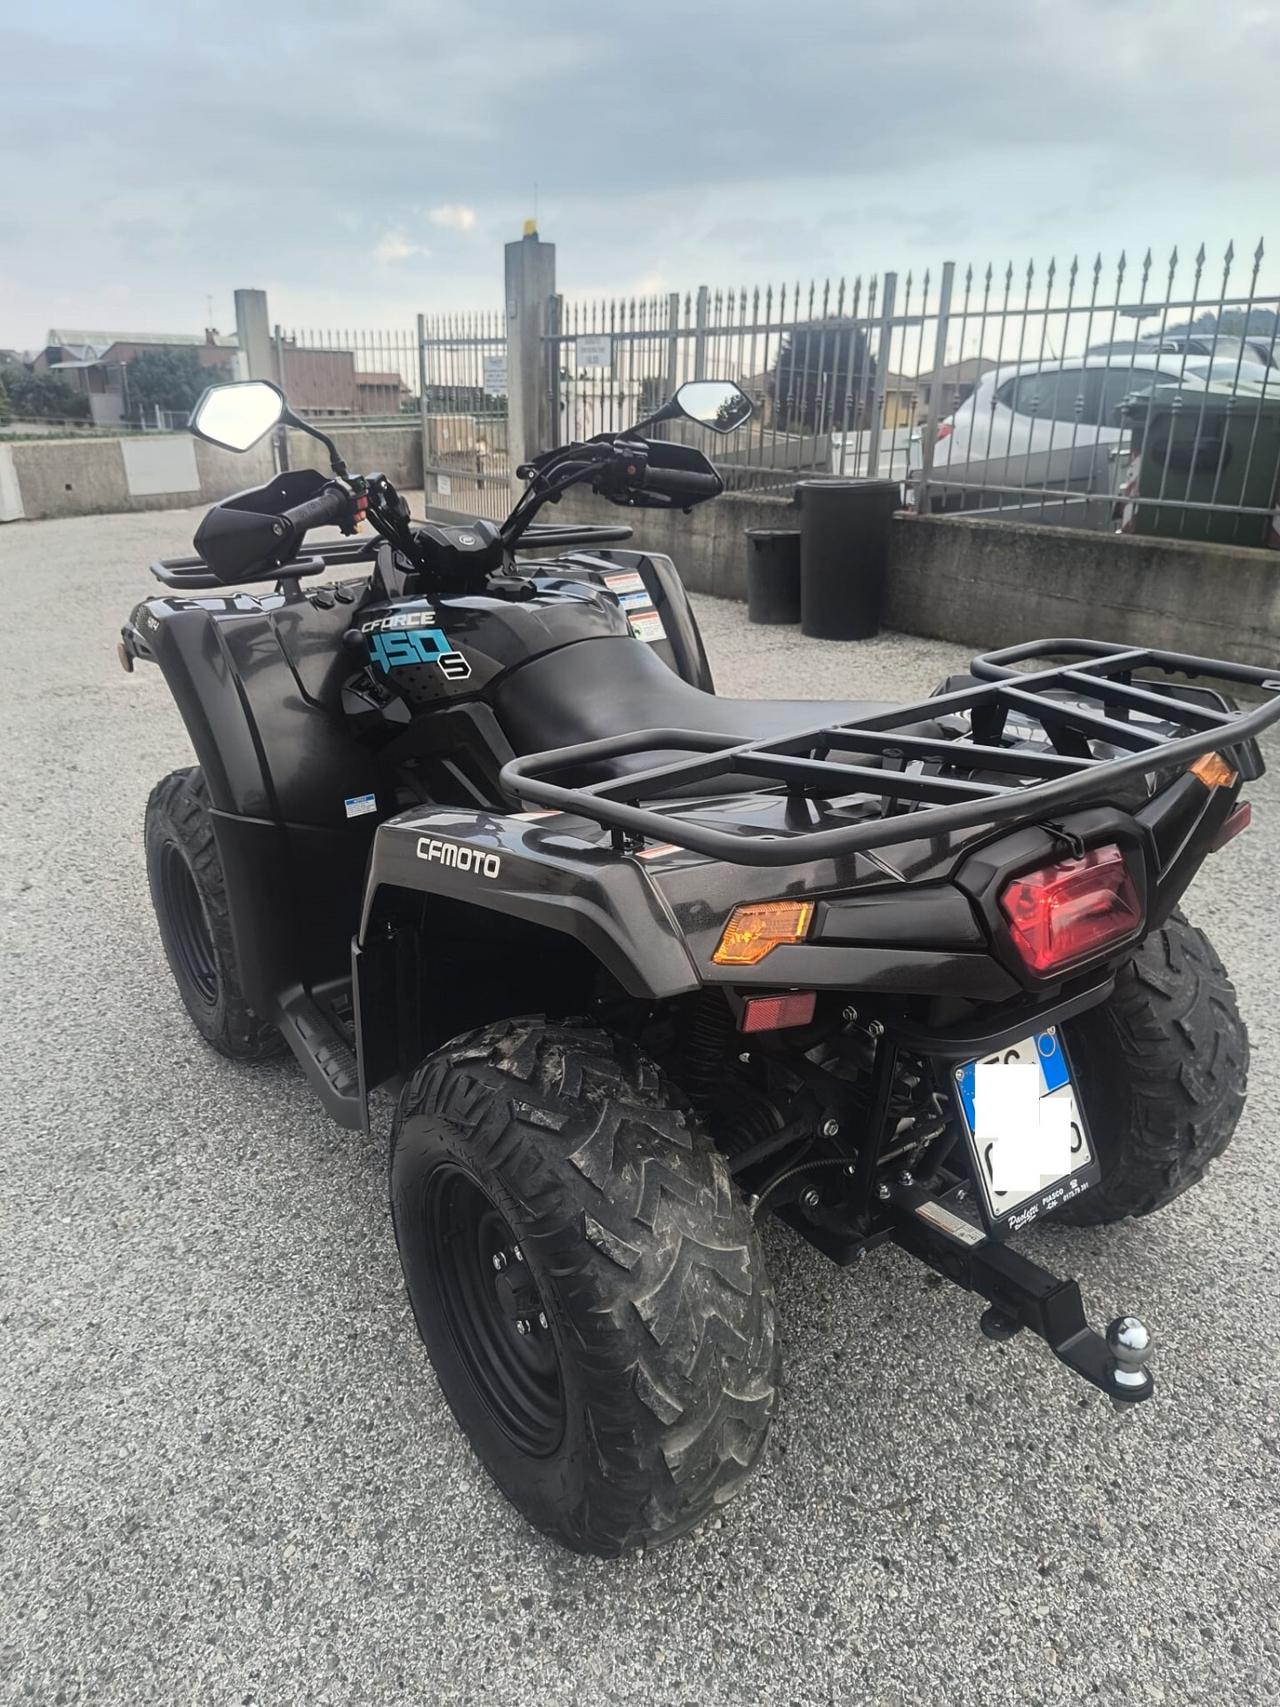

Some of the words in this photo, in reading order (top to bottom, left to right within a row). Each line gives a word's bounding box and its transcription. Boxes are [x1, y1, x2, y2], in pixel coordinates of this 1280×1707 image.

[361, 611, 436, 633] CFORCE
[369, 628, 453, 675] 450
[437, 651, 472, 680] S
[416, 837, 501, 879] CFMOTO
